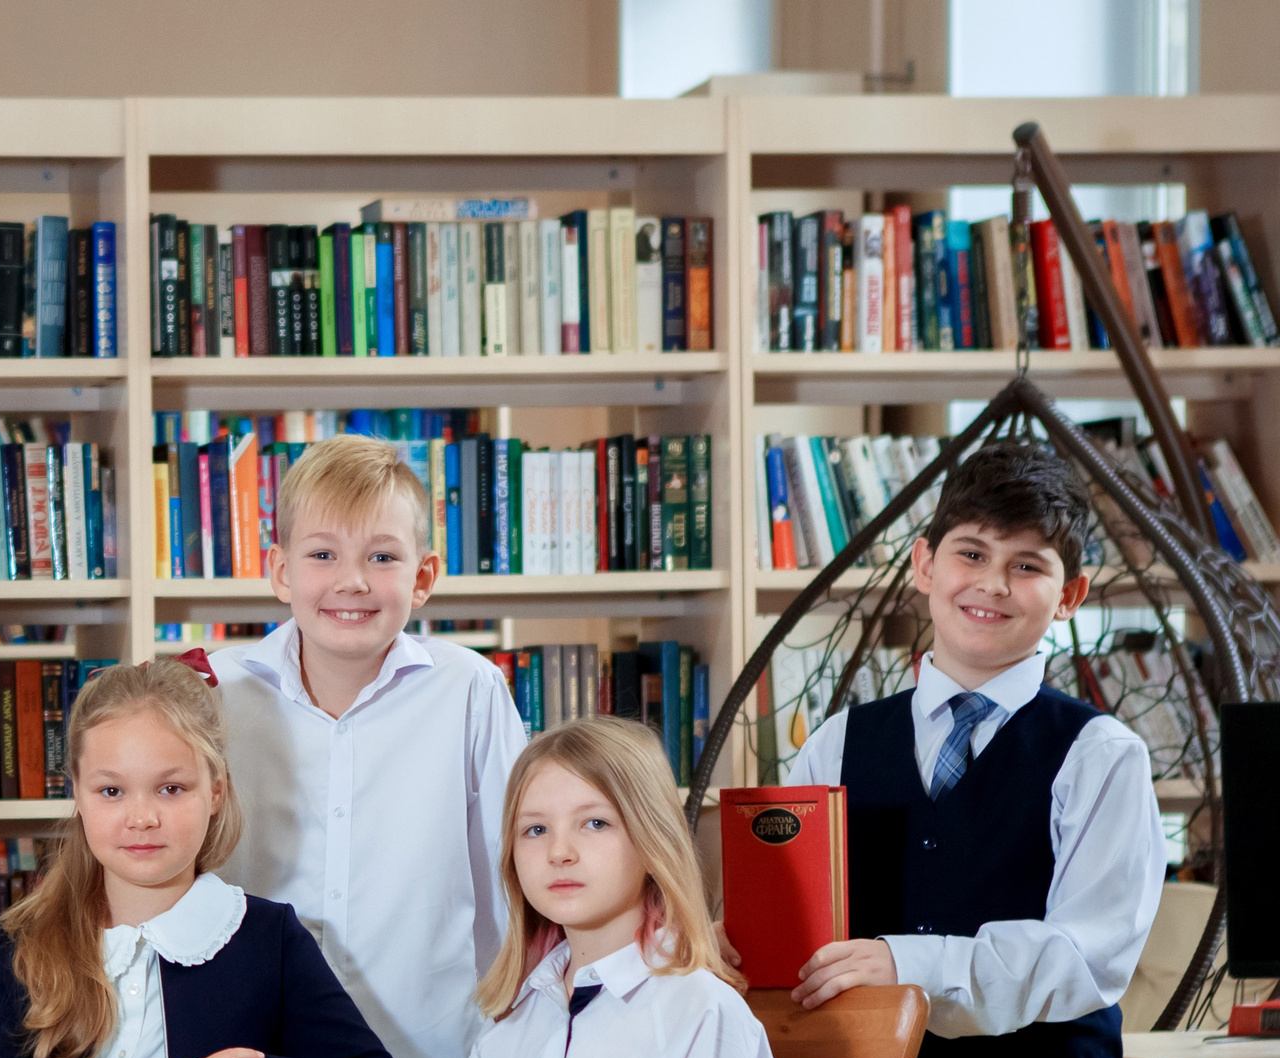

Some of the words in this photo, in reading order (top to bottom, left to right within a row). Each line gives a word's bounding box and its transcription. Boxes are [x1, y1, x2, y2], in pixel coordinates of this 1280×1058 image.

[191, 242, 201, 275] МОРУА
[166, 284, 175, 333] МЮССО
[278, 289, 287, 337] МЮССО
[293, 293, 302, 341] МЮССО
[309, 292, 318, 340] МЮССО
[497, 454, 508, 498] САГАН
[499, 501, 509, 560] ФРАНСУАЗА
[651, 503, 662, 554] СИМЕНОН
[651, 555, 662, 569] Ж.
[2, 689, 13, 721] ДЮМА
[3, 723, 14, 777] АЛЕКСАНДР
[47, 728, 56, 771] ПУСТЫНИ
[755, 823, 797, 836] ФРАНС
[758, 816, 795, 825] АНАТОЛЬ
